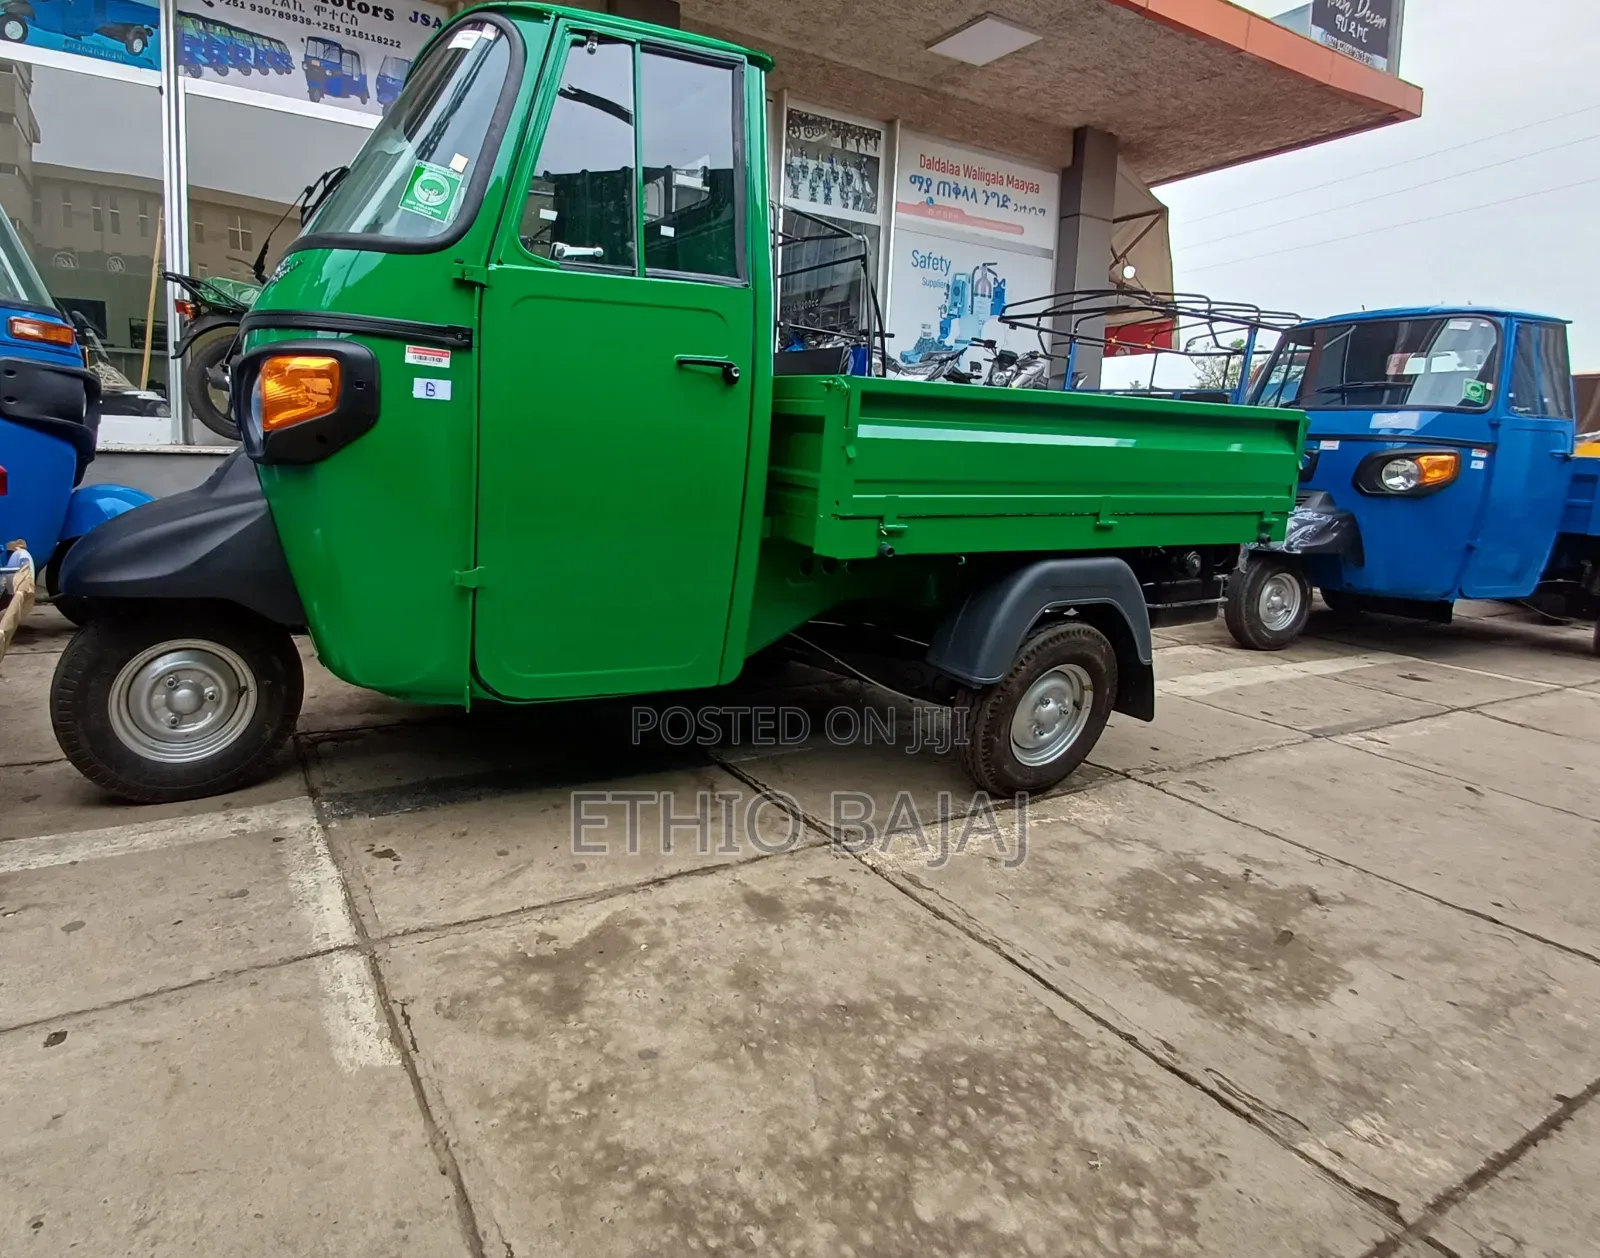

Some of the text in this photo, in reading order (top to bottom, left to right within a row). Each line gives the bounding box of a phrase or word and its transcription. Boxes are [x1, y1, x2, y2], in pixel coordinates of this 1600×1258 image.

[219, 0, 246, 9] 251
[345, 28, 401, 48] 915118222
[316, 0, 443, 29] otors JSA
[919, 153, 1040, 194] Daldalaa Waliigala Maayaa
[909, 174, 933, 194] ማያ
[982, 189, 1011, 209] ንግድ
[911, 249, 952, 277] Safety
[425, 381, 436, 397] B
